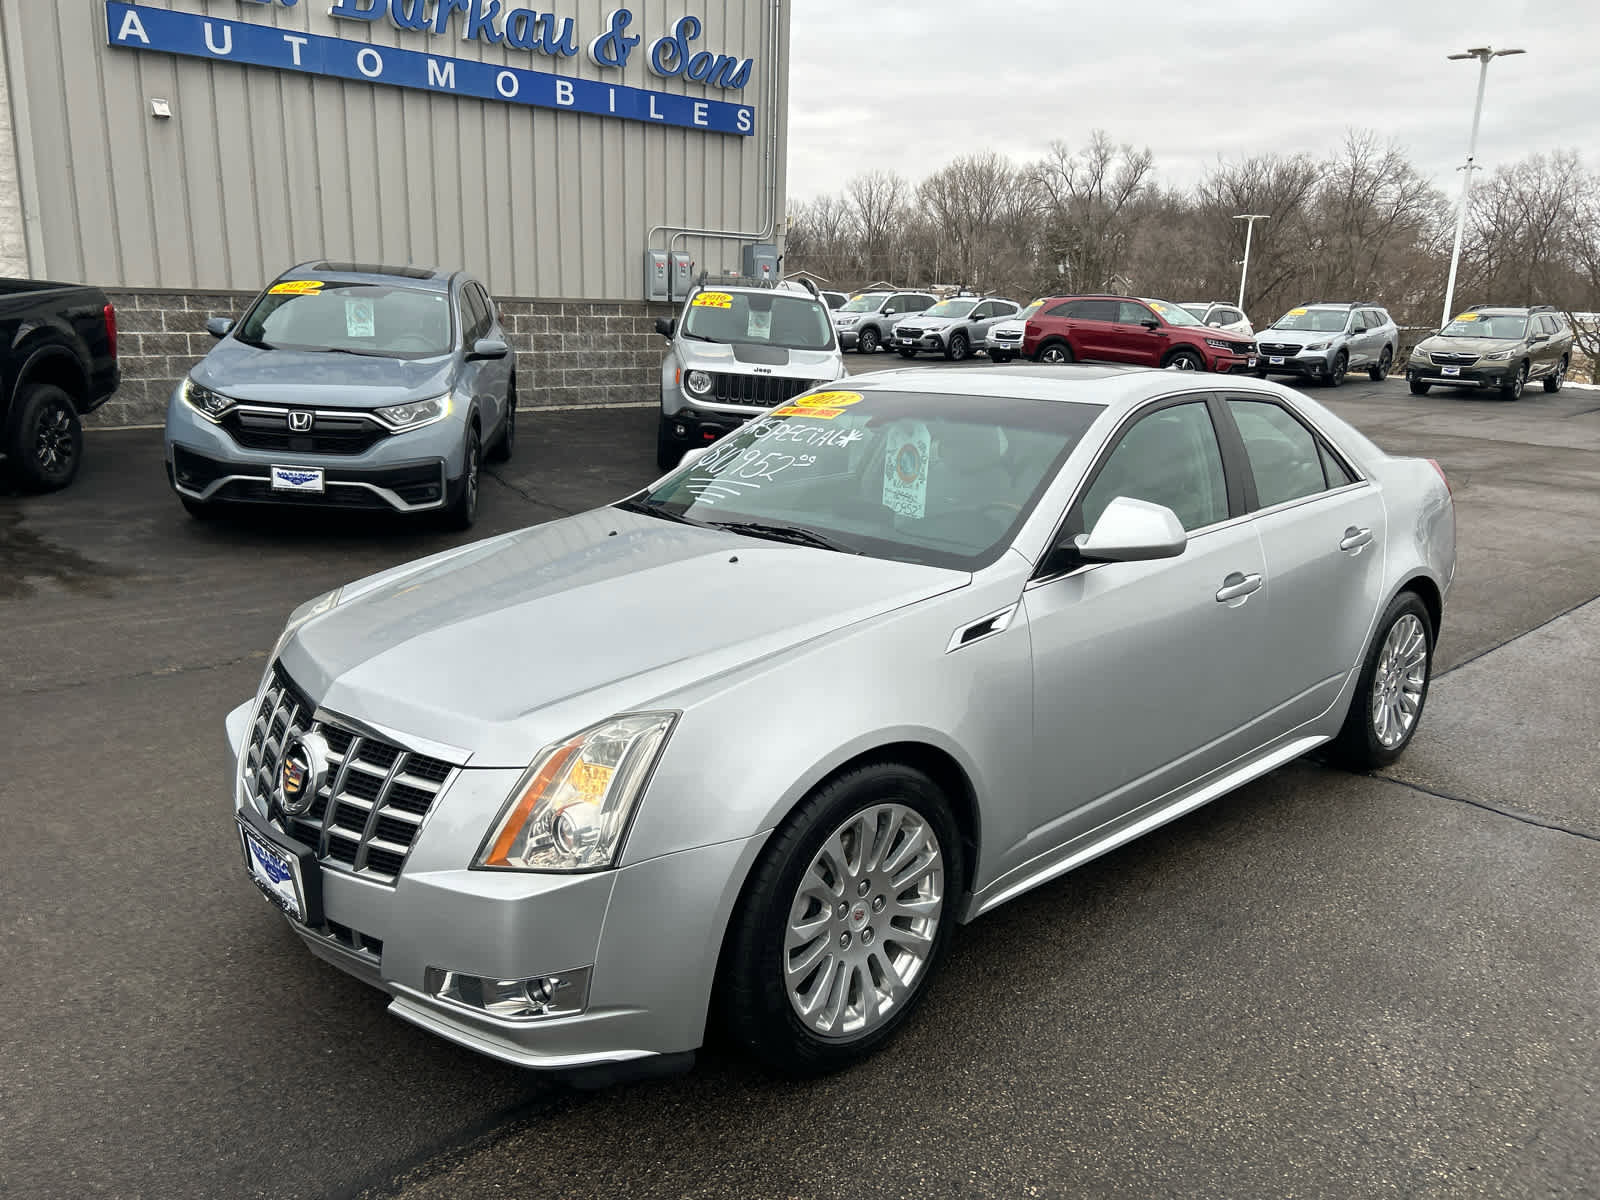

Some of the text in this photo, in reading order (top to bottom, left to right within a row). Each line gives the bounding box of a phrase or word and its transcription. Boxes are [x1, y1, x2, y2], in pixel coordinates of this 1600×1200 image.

[117, 8, 752, 132] AUTOMOBILES
[588, 8, 641, 67] &
[647, 15, 754, 89] Sons
